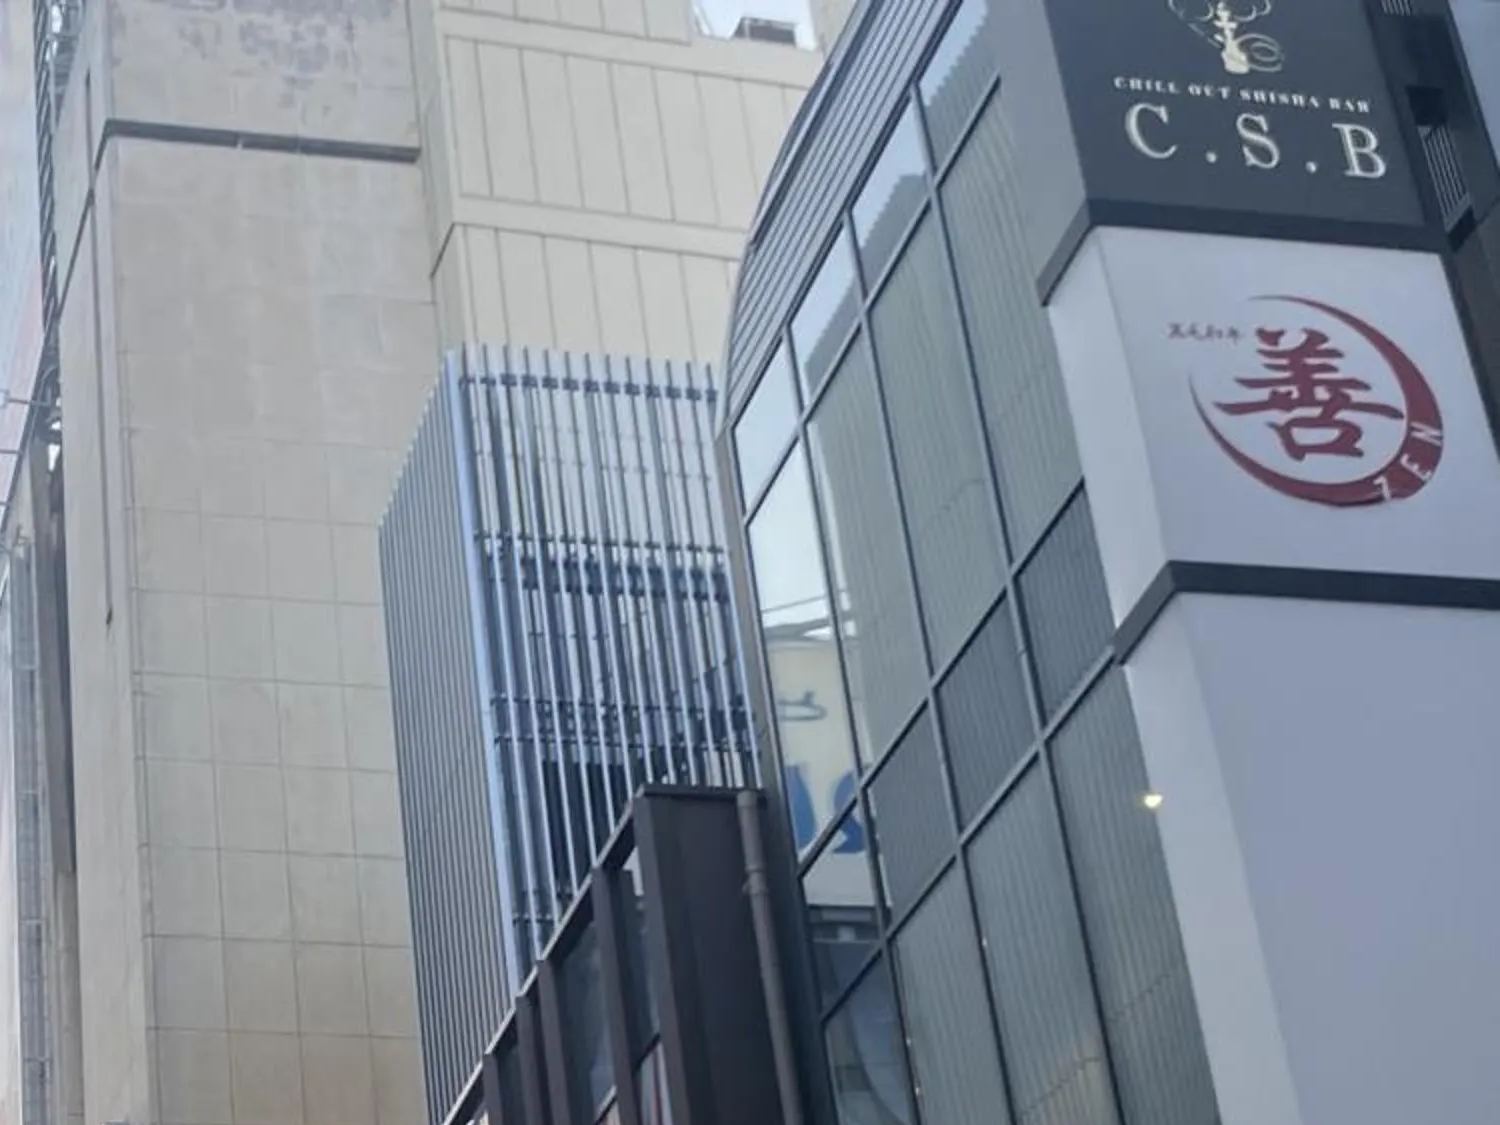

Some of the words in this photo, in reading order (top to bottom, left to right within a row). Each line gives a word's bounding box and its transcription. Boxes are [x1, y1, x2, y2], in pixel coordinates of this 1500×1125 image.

[1113, 75, 1181, 95] CHILL
[1187, 82, 1232, 100] OUT
[1239, 88, 1321, 109] SHISHA
[1328, 97, 1371, 113] BAR
[1213, 327, 1406, 463] 善
